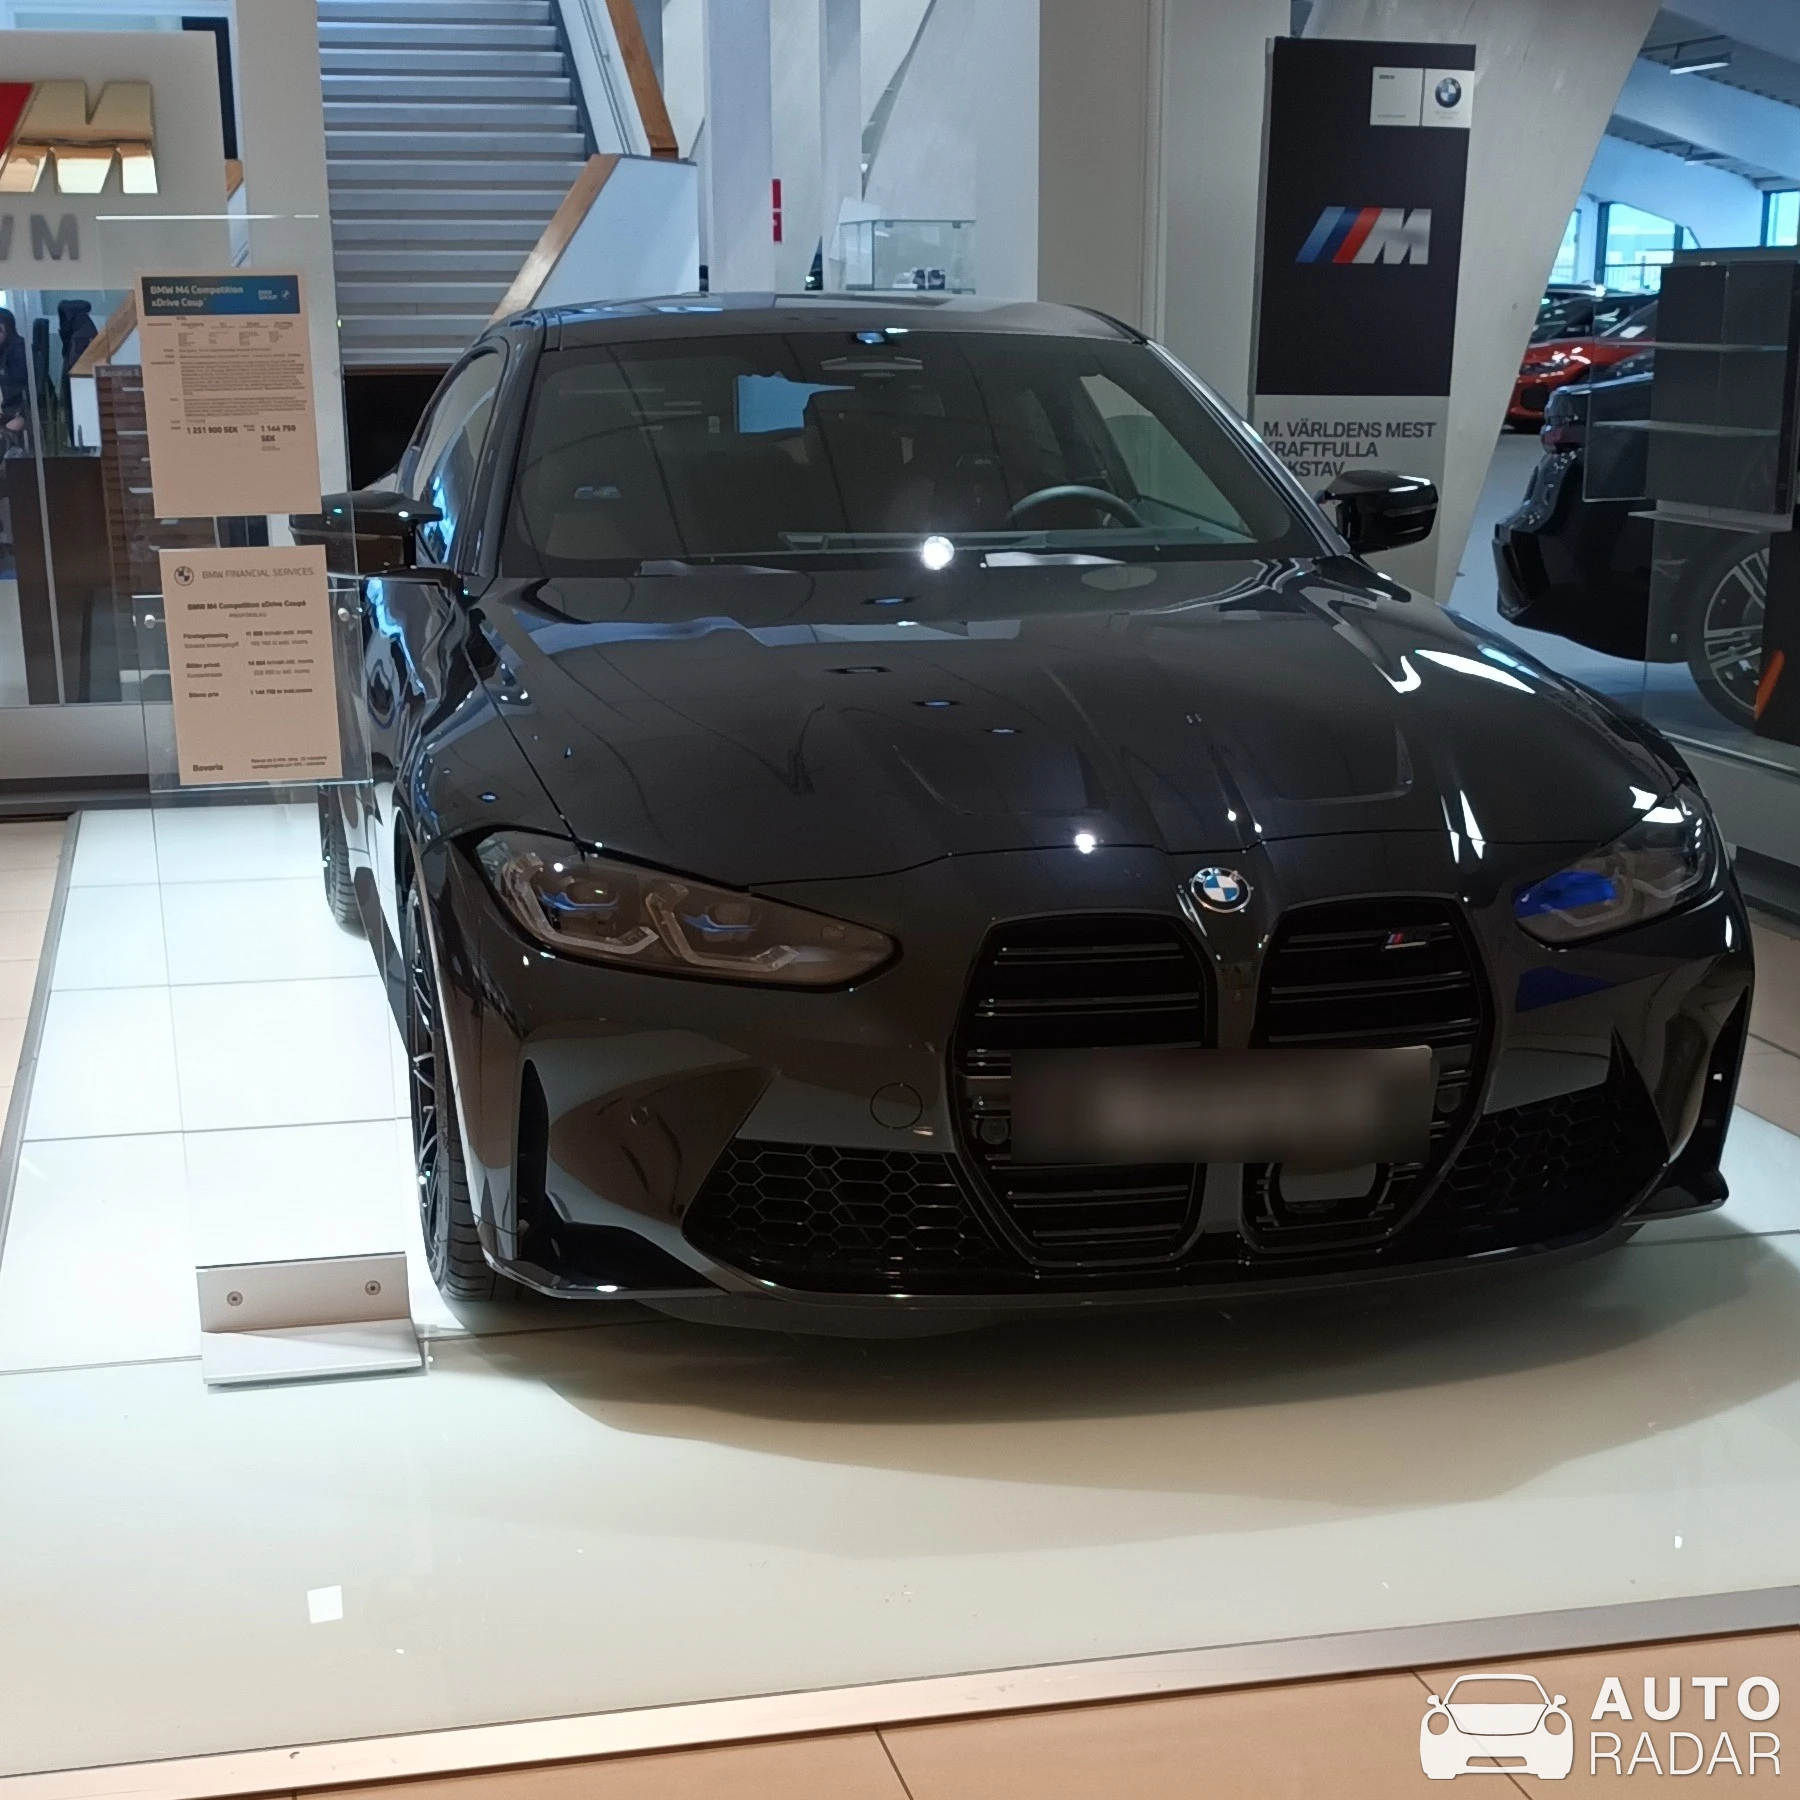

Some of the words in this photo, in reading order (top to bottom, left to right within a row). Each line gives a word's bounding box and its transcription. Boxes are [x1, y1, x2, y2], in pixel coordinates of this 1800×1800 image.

[1352, 207, 1432, 264] M
[150, 285, 174, 295] BMW
[175, 285, 190, 295] M4
[191, 285, 244, 296] Competition
[151, 298, 180, 307] xDrive
[223, 425, 238, 434] SEK
[1263, 421, 1283, 438] M.
[1286, 417, 1382, 438] VÄRLDENS
[1385, 421, 1437, 438] MEST
[261, 434, 276, 442] SEK
[1284, 461, 1346, 477] KSTAV
[202, 570, 224, 579] BMW
[225, 568, 271, 579] FINANCIAL
[219, 601, 260, 611] Competition
[192, 763, 224, 772] Bavaria
